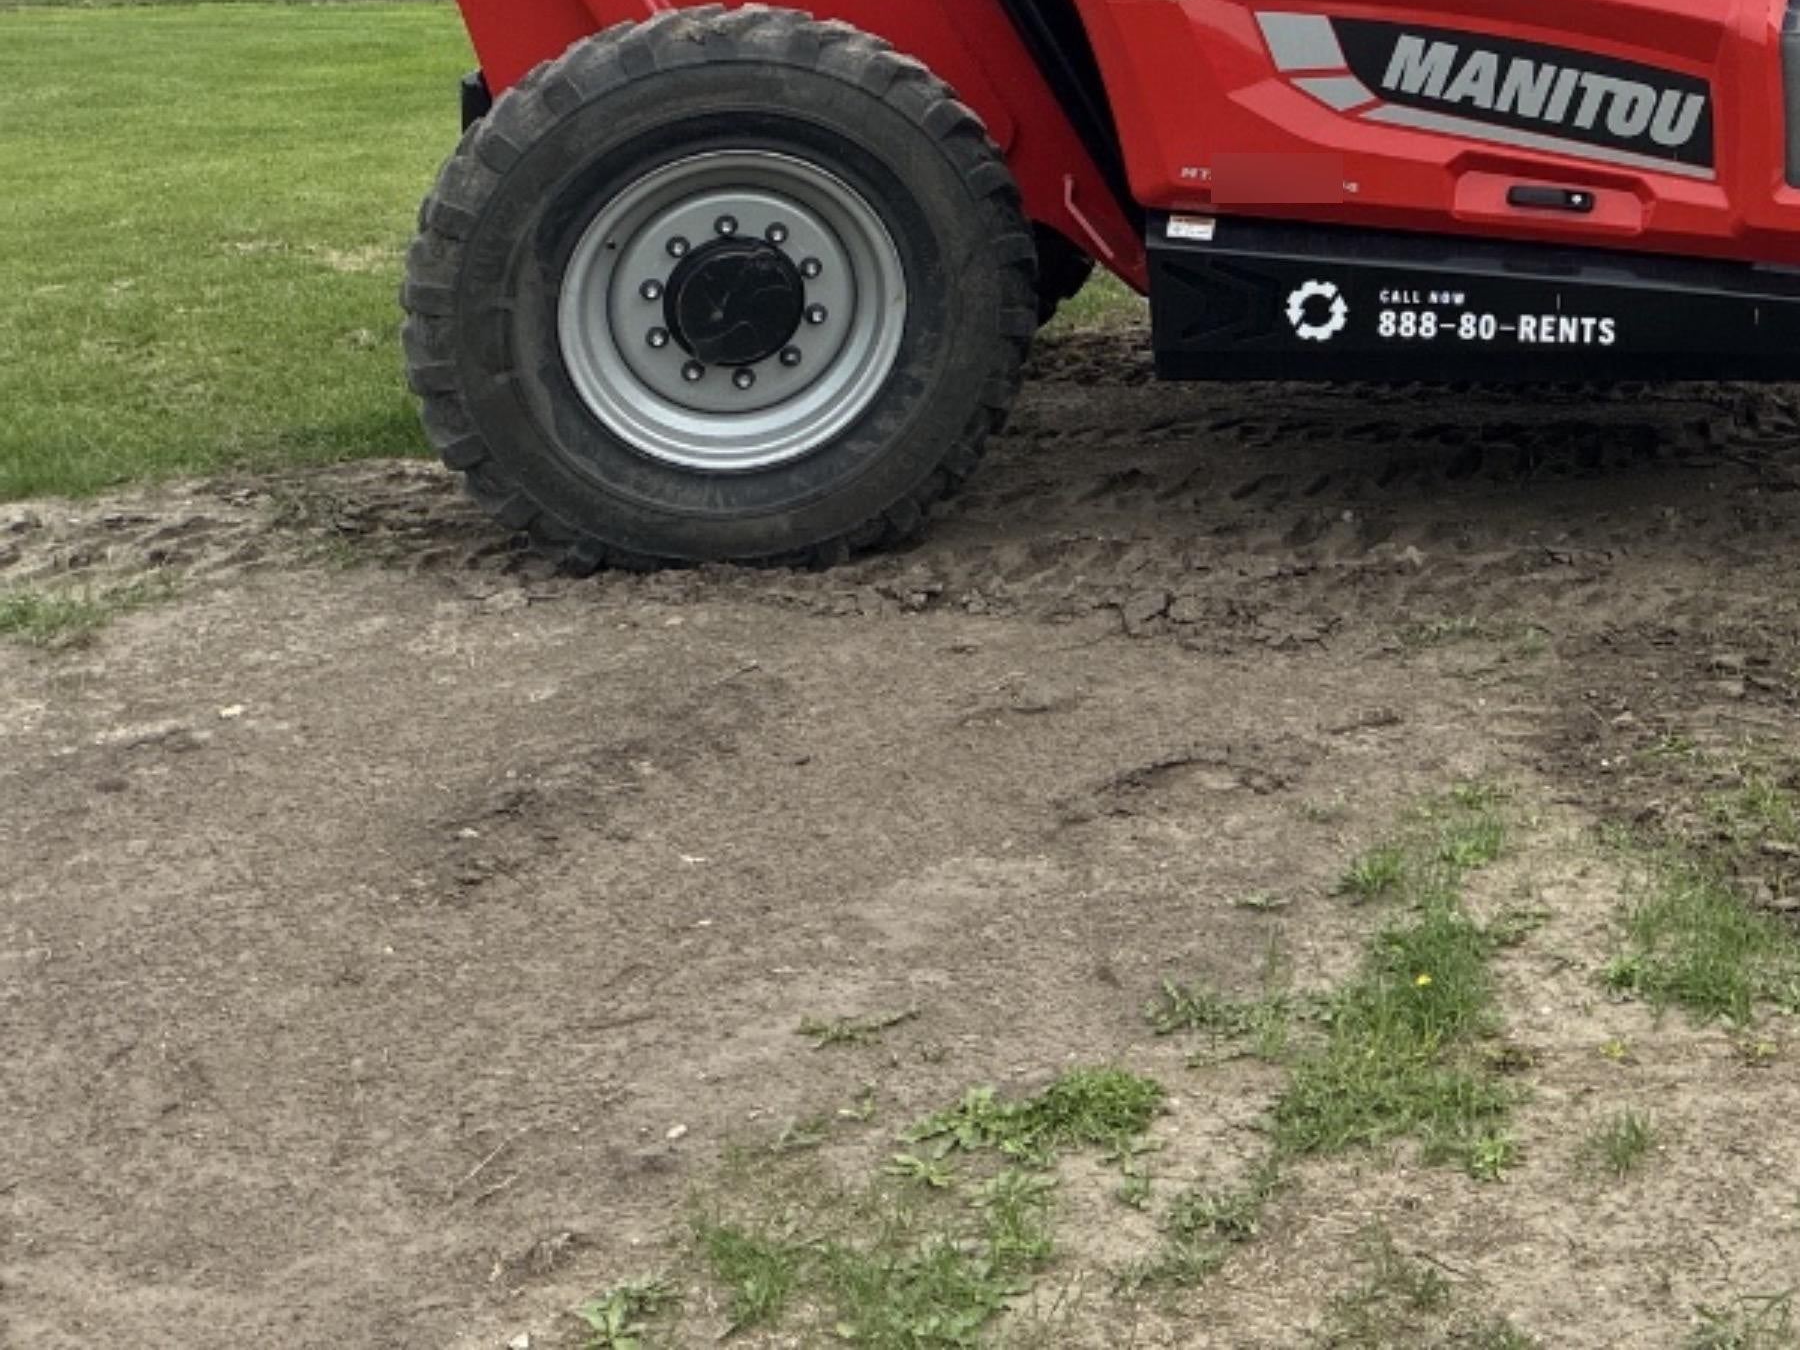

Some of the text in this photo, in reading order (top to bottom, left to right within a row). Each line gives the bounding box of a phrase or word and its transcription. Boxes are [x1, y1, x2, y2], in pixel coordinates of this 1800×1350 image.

[1381, 34, 1706, 146] MANITOU
[1378, 289, 1466, 306] CALL NOW
[1377, 310, 1617, 346] 888-80-RENTS
